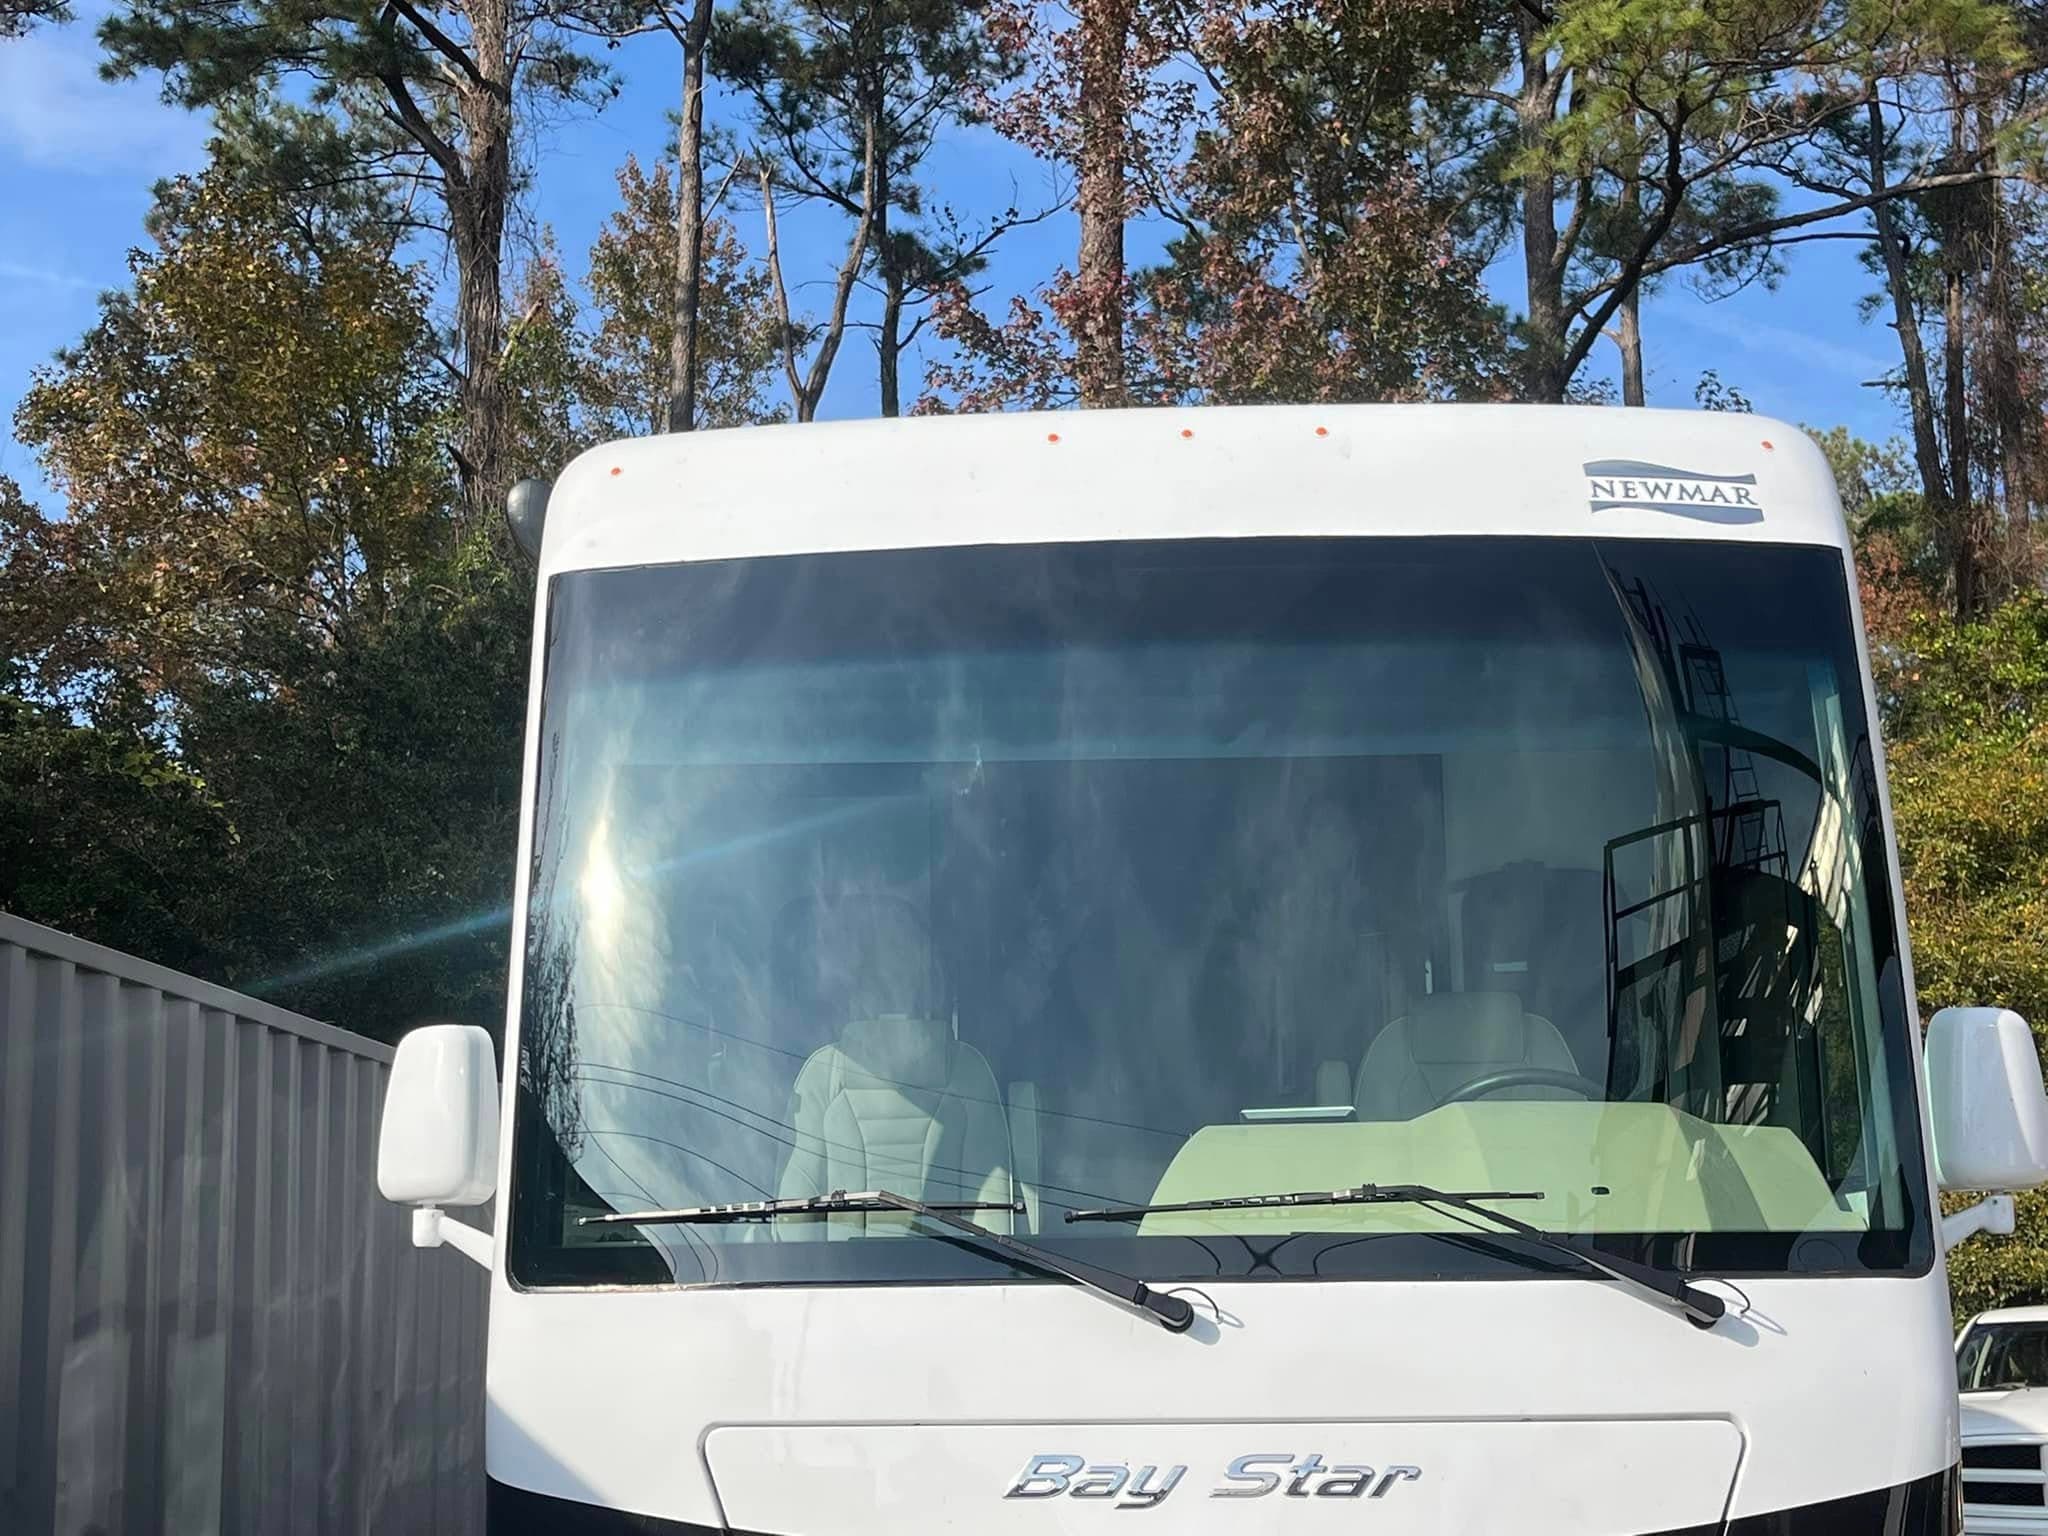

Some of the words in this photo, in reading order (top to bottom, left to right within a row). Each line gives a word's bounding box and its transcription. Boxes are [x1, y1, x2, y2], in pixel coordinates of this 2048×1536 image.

[1590, 479, 1759, 505] NEWMAR
[1002, 1453, 1188, 1510] Bay
[1209, 1453, 1423, 1499] Star
